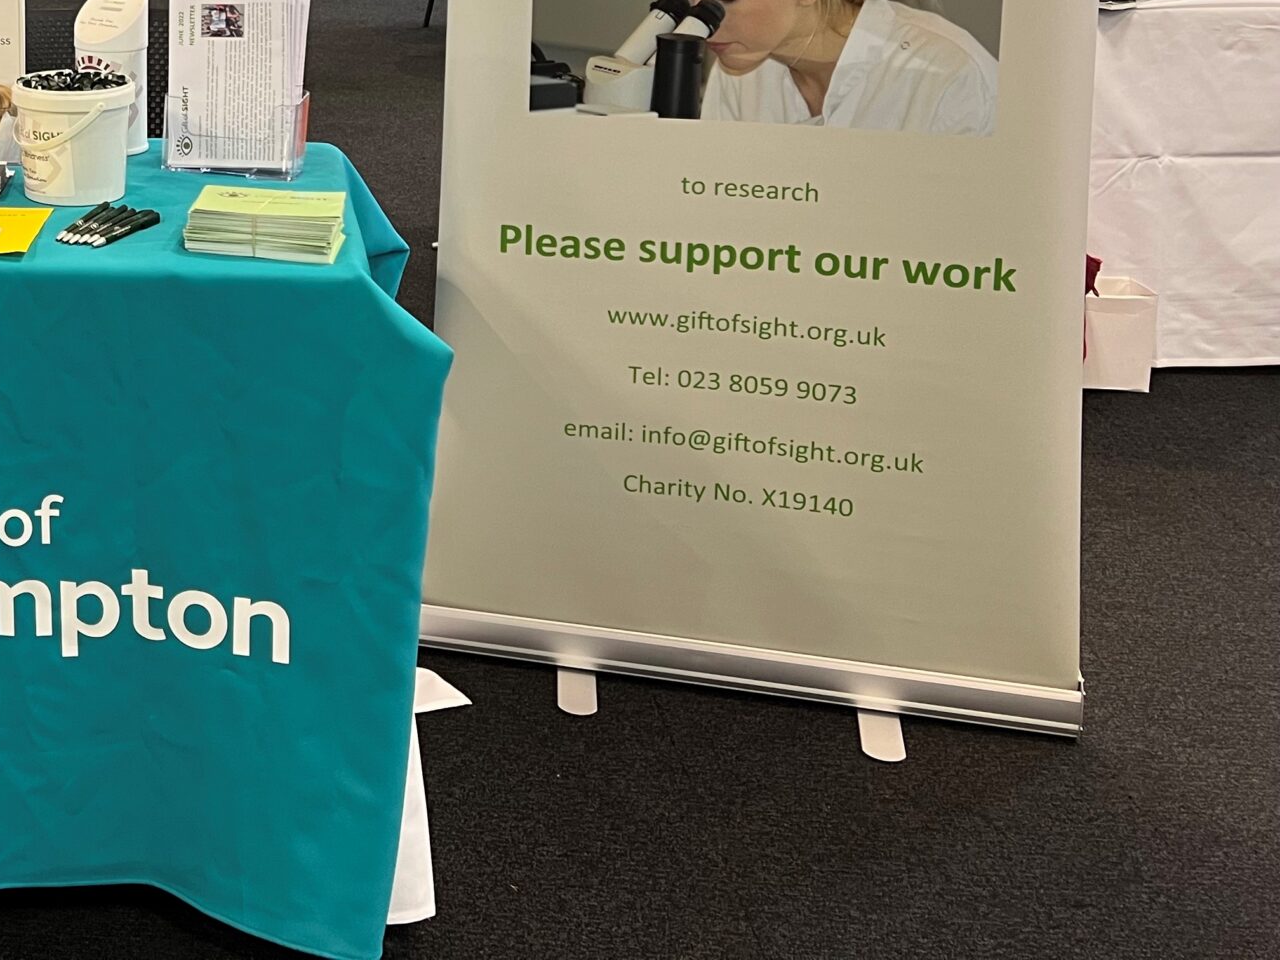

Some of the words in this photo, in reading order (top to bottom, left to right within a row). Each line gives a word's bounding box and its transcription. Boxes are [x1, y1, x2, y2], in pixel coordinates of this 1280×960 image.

[681, 177, 706, 196] to
[714, 177, 819, 203] research
[499, 225, 625, 261] Please
[639, 235, 801, 275] support
[814, 254, 888, 280] our
[903, 257, 1017, 292] work
[607, 308, 886, 348] www.giftofsight.org.uk
[629, 366, 670, 388] Tel:
[678, 370, 721, 391] 023
[729, 375, 788, 398] 8059
[796, 381, 858, 405] 9073
[564, 420, 633, 441] email:
[641, 425, 924, 474] info@giftofsight.org.uk
[623, 474, 706, 503] Charity
[714, 482, 752, 504] No.
[762, 489, 854, 517] X19140
